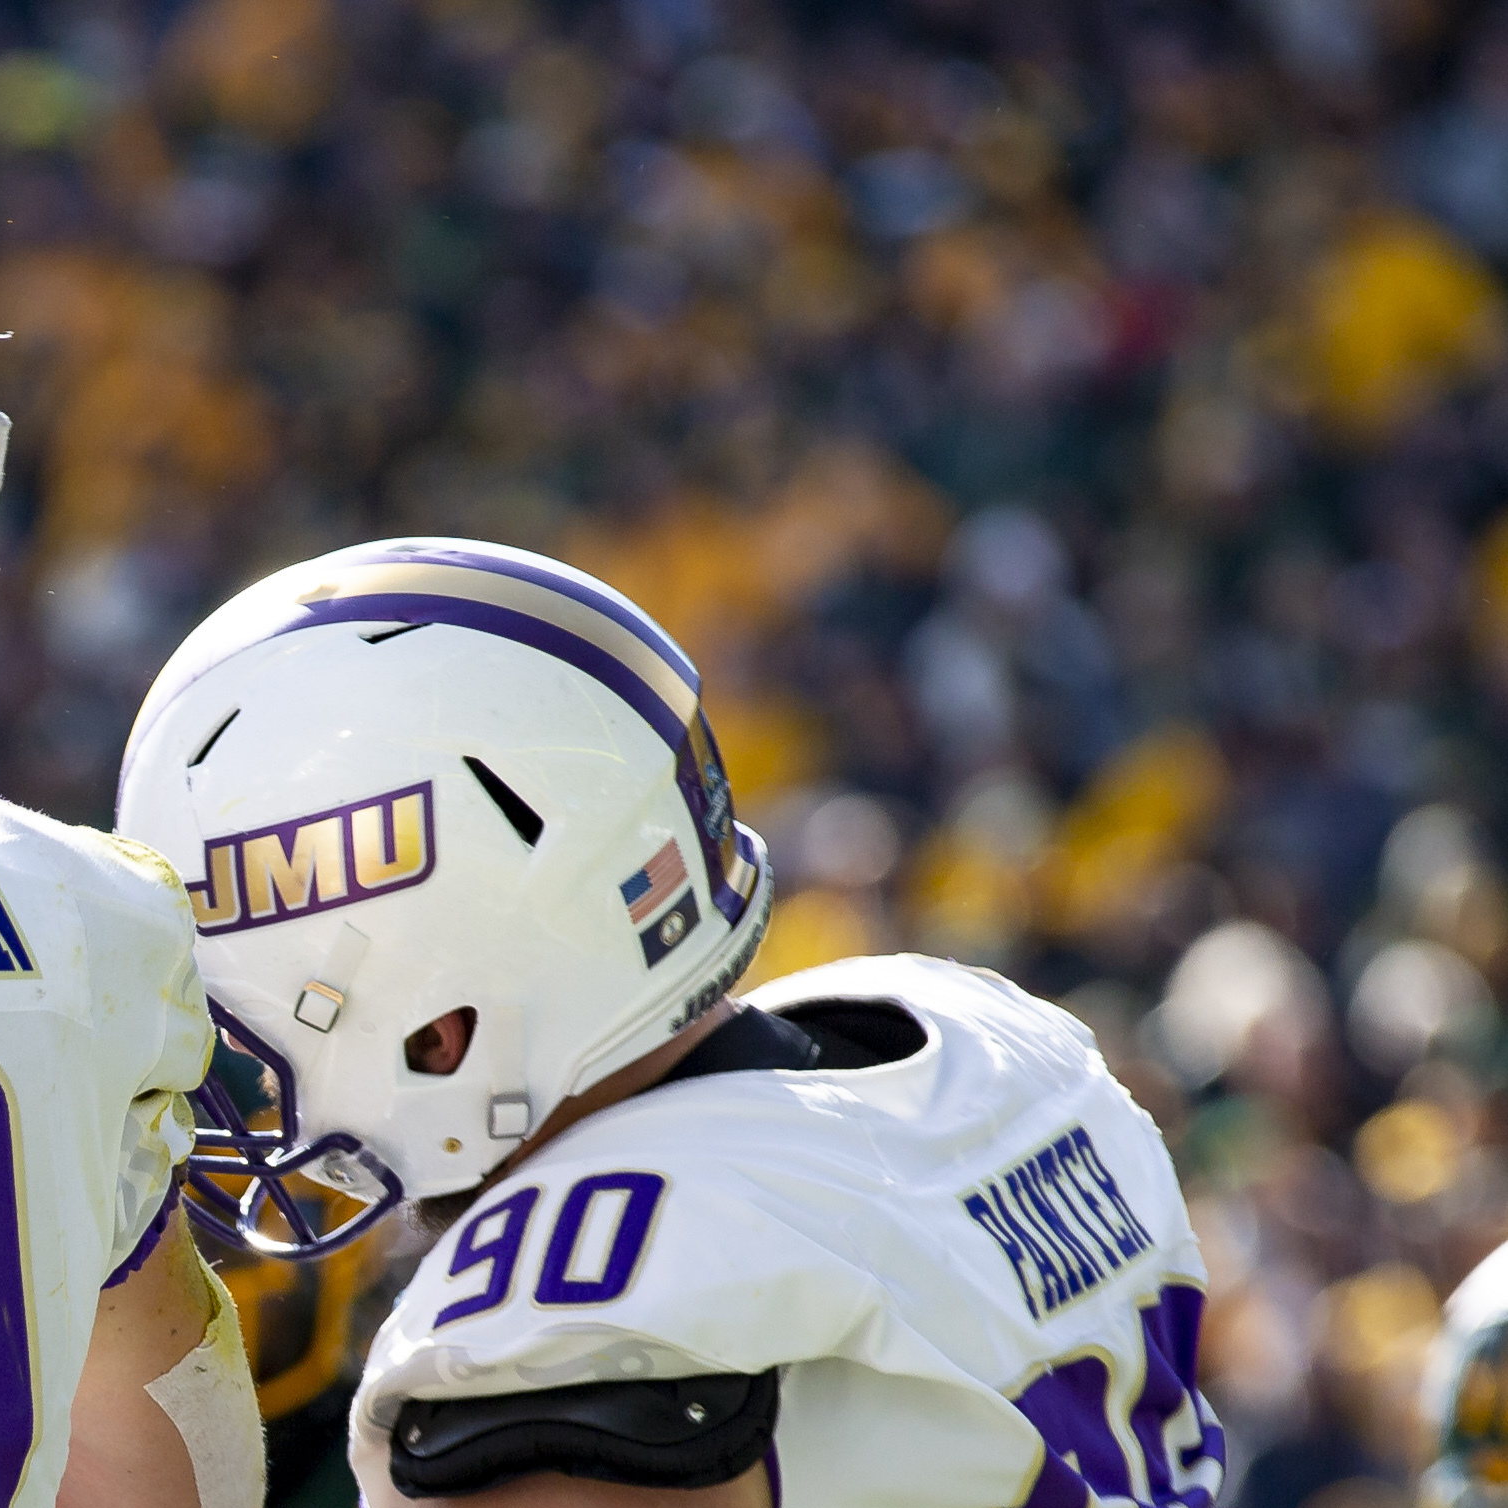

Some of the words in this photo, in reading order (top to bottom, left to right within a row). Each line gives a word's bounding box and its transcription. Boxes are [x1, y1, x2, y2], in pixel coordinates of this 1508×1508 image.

[189, 792, 425, 928] JMU
[432, 1169, 671, 1331] 90
[961, 1124, 1155, 1323] PAINTER
